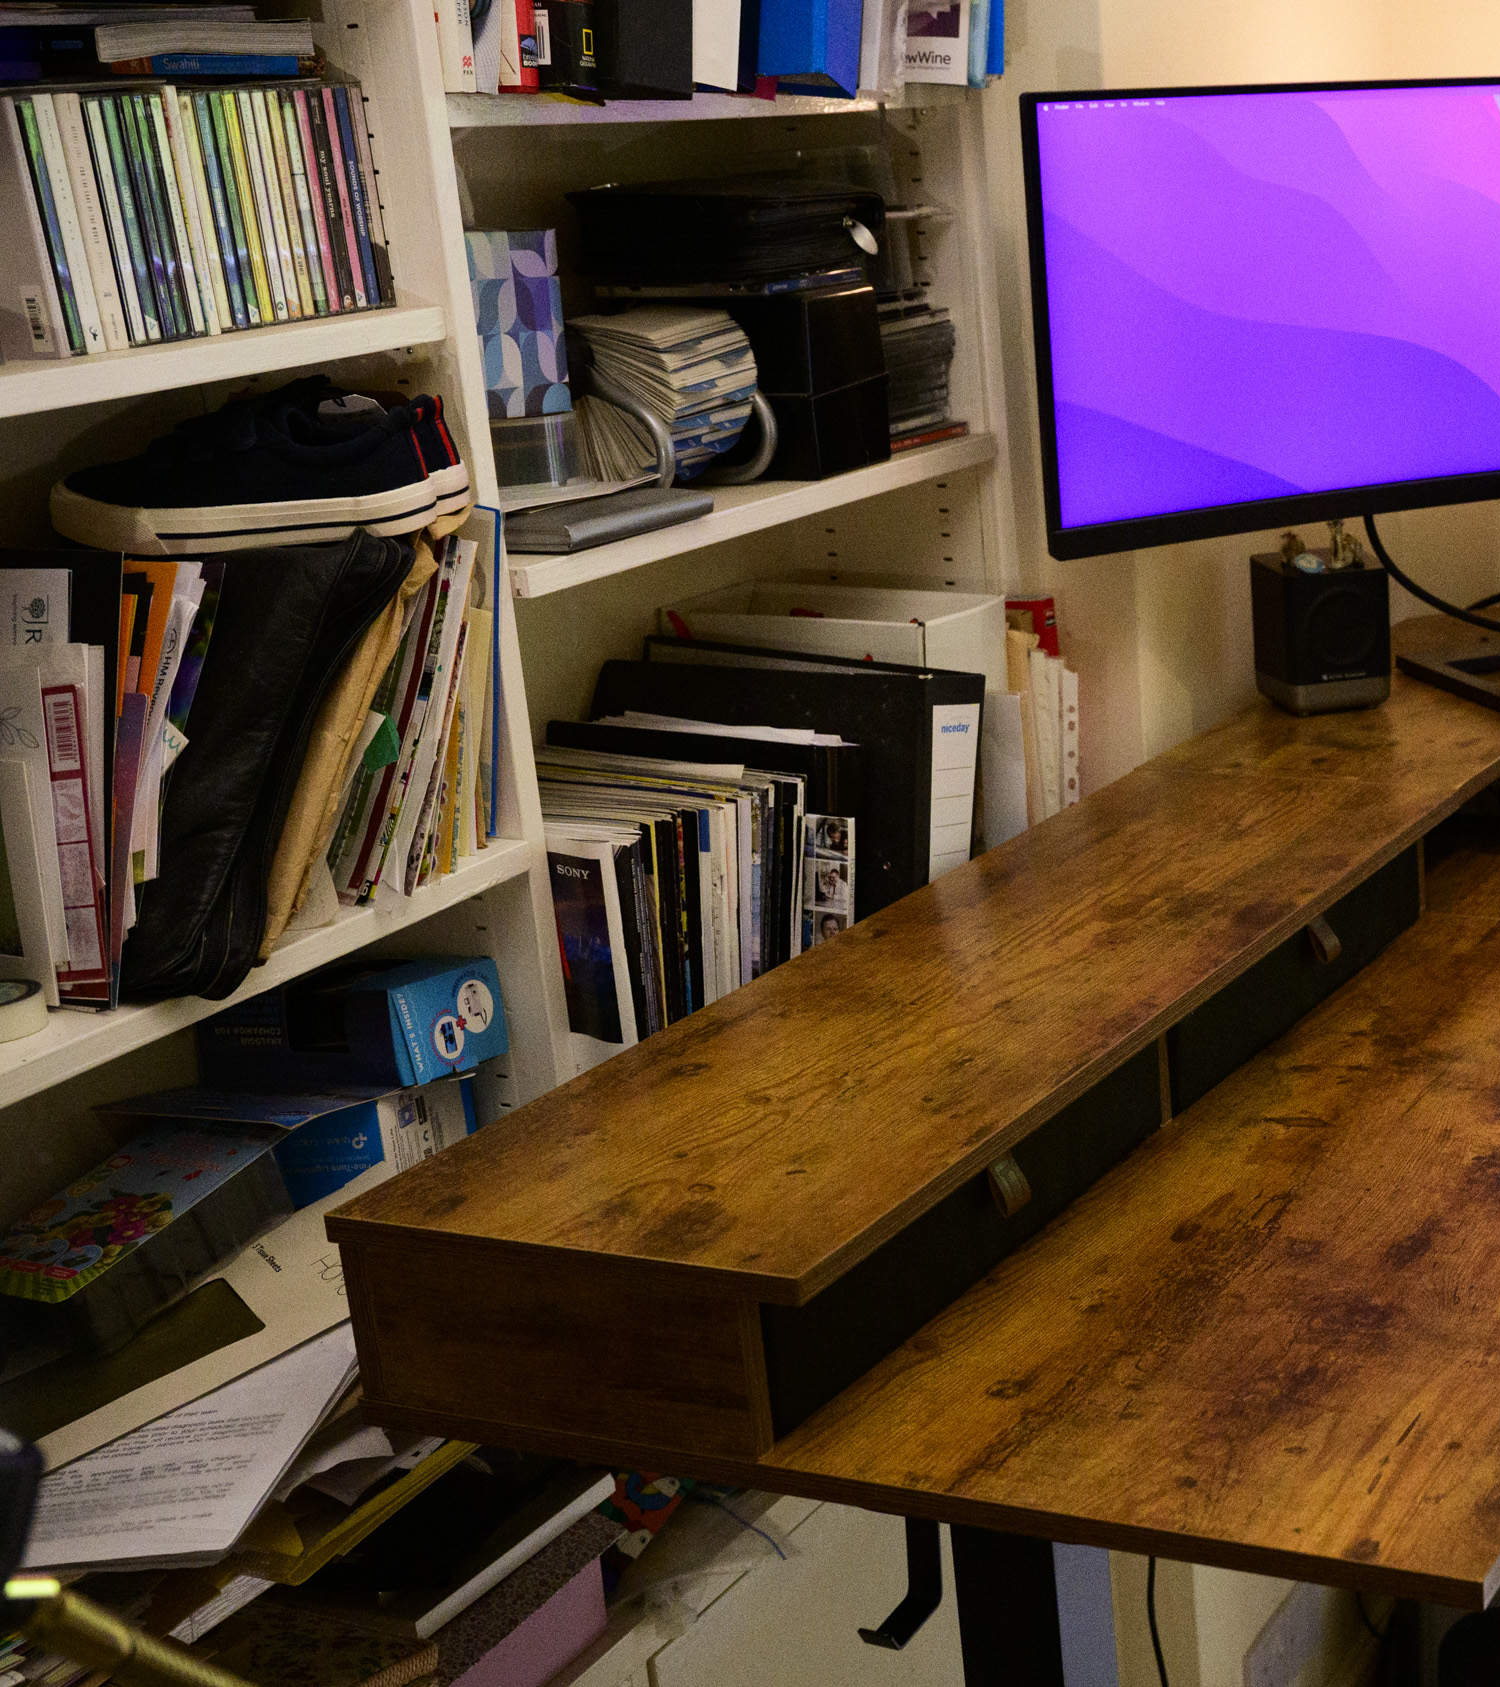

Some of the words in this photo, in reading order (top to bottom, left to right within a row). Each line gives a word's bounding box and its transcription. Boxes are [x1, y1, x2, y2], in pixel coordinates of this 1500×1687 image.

[163, 58, 200, 71] Swahili
[319, 150, 327, 164] my
[322, 166, 331, 185] soul
[348, 160, 357, 190] SOUNDS
[121, 184, 134, 218] COMPASS
[325, 187, 336, 218] yearns
[353, 192, 360, 202] OF
[355, 203, 365, 236] WORSHIP
[160, 656, 172, 676] HM
[941, 722, 970, 734] niceday
[556, 864, 590, 880] SONY
[397, 993, 413, 1030] INSIDE?
[409, 1032, 424, 1073] WHAT'S
[330, 1162, 371, 1172] Fine-Tune
[265, 1255, 282, 1273] Sheets
